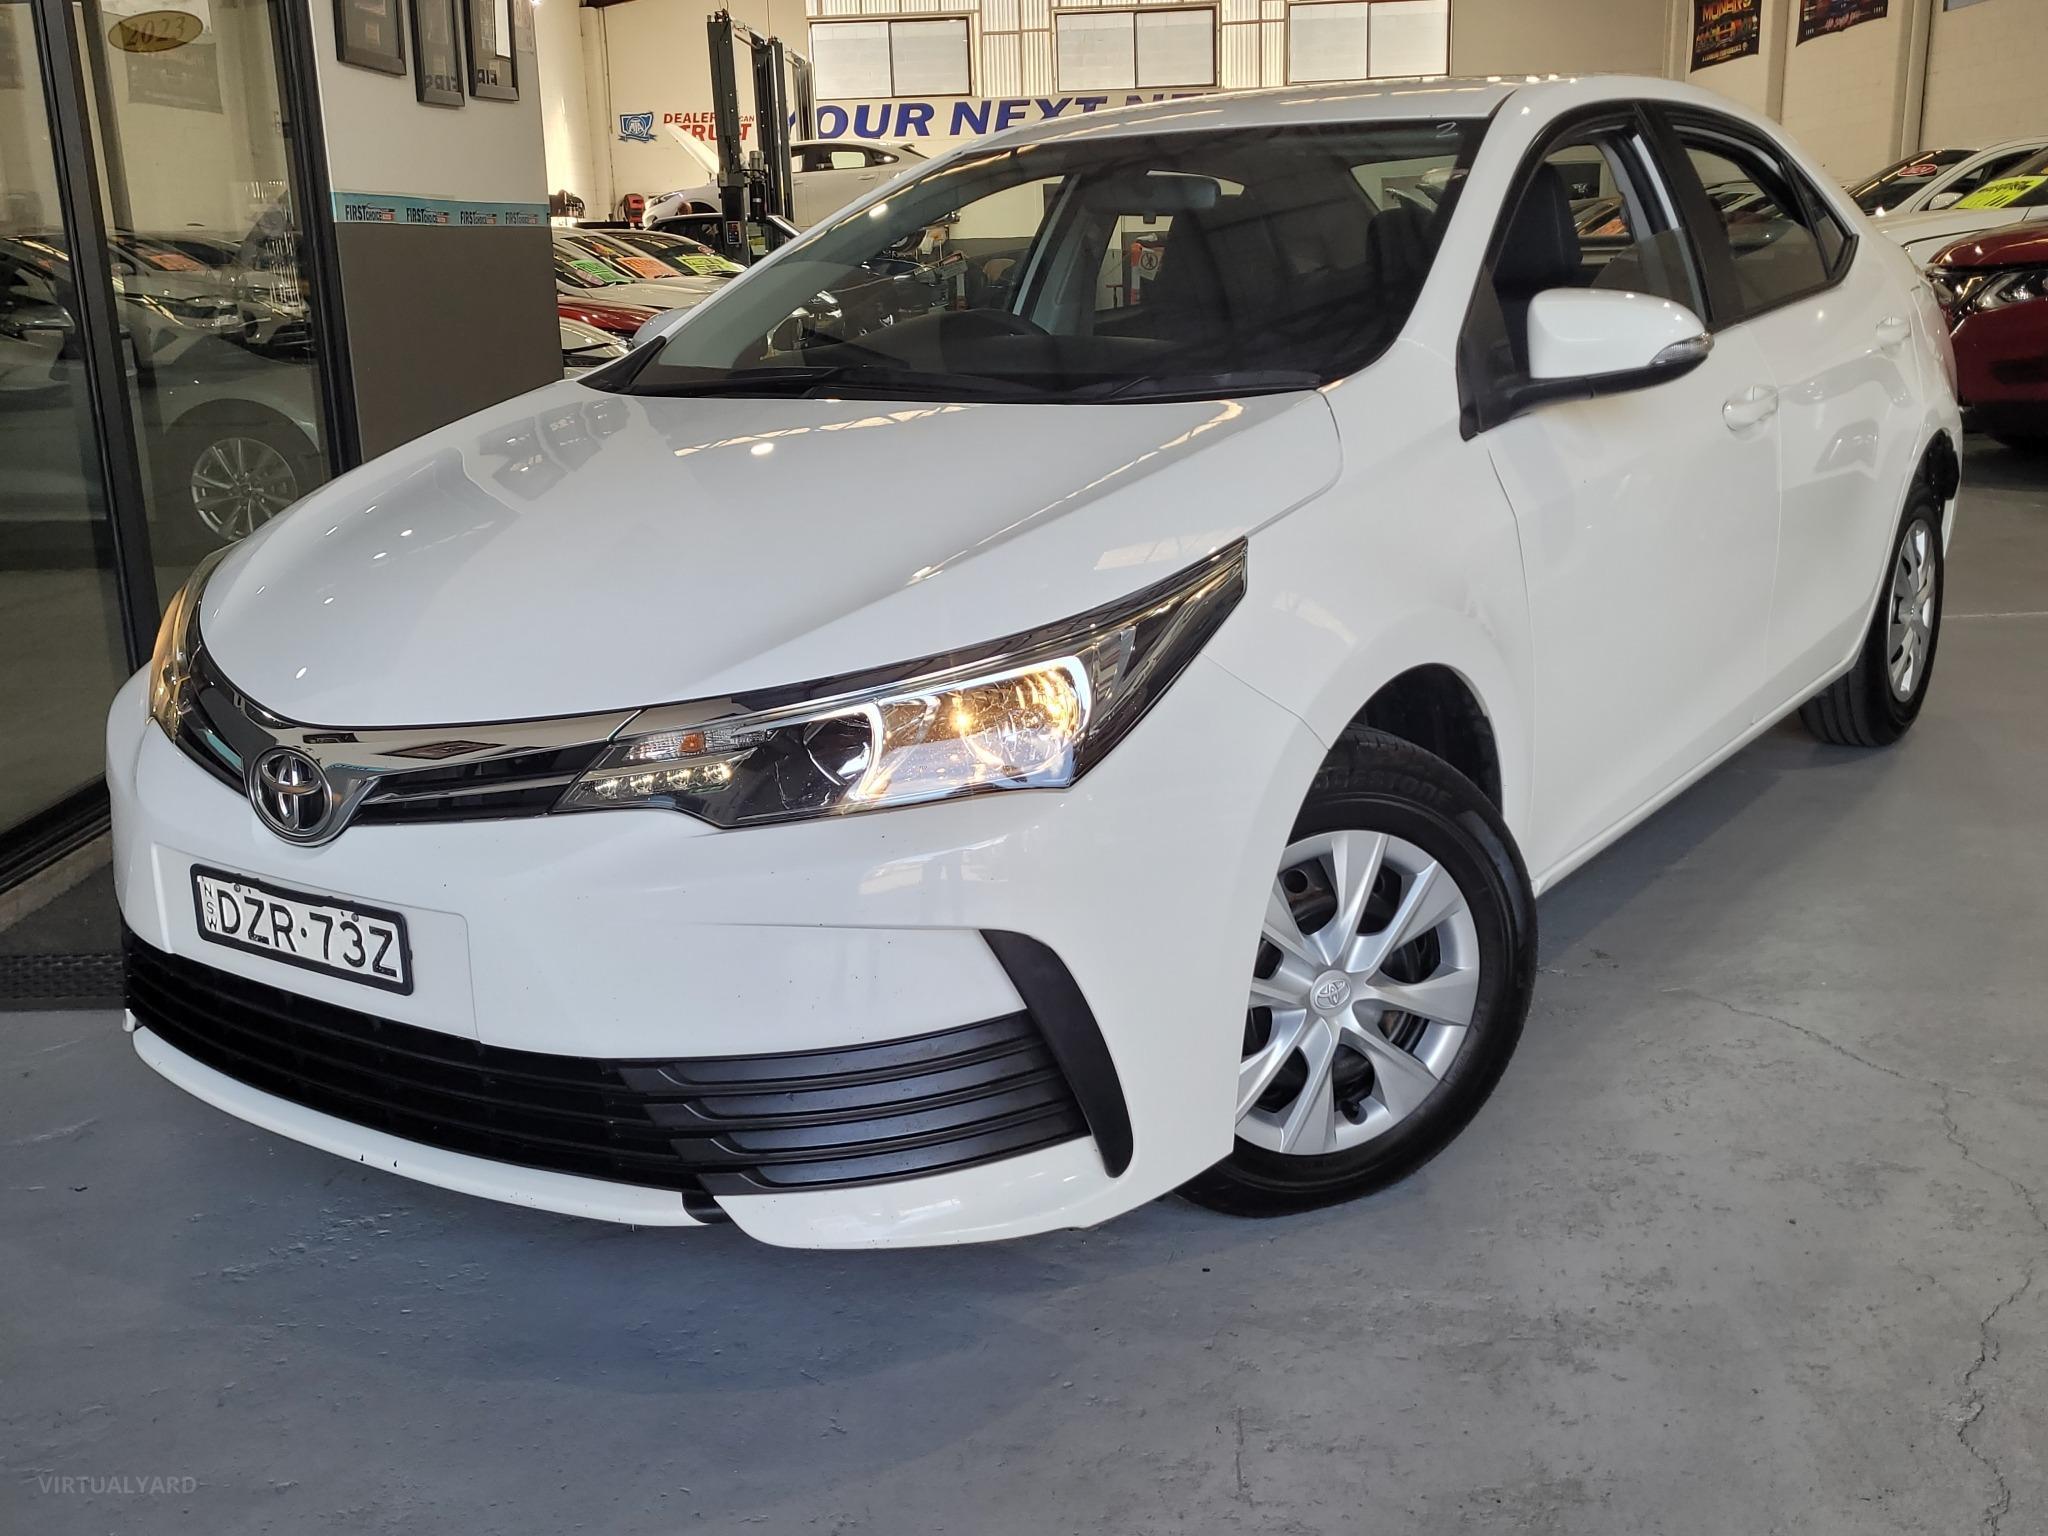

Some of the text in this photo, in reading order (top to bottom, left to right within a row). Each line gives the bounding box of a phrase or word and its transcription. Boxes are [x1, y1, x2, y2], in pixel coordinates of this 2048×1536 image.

[789, 103, 935, 139] OUR
[679, 123, 752, 141] TRUT
[345, 205, 366, 221] FIRST
[406, 207, 425, 223] FIRST
[460, 211, 475, 224] FIRST
[505, 211, 520, 224] FIRST
[204, 883, 217, 931] NSW
